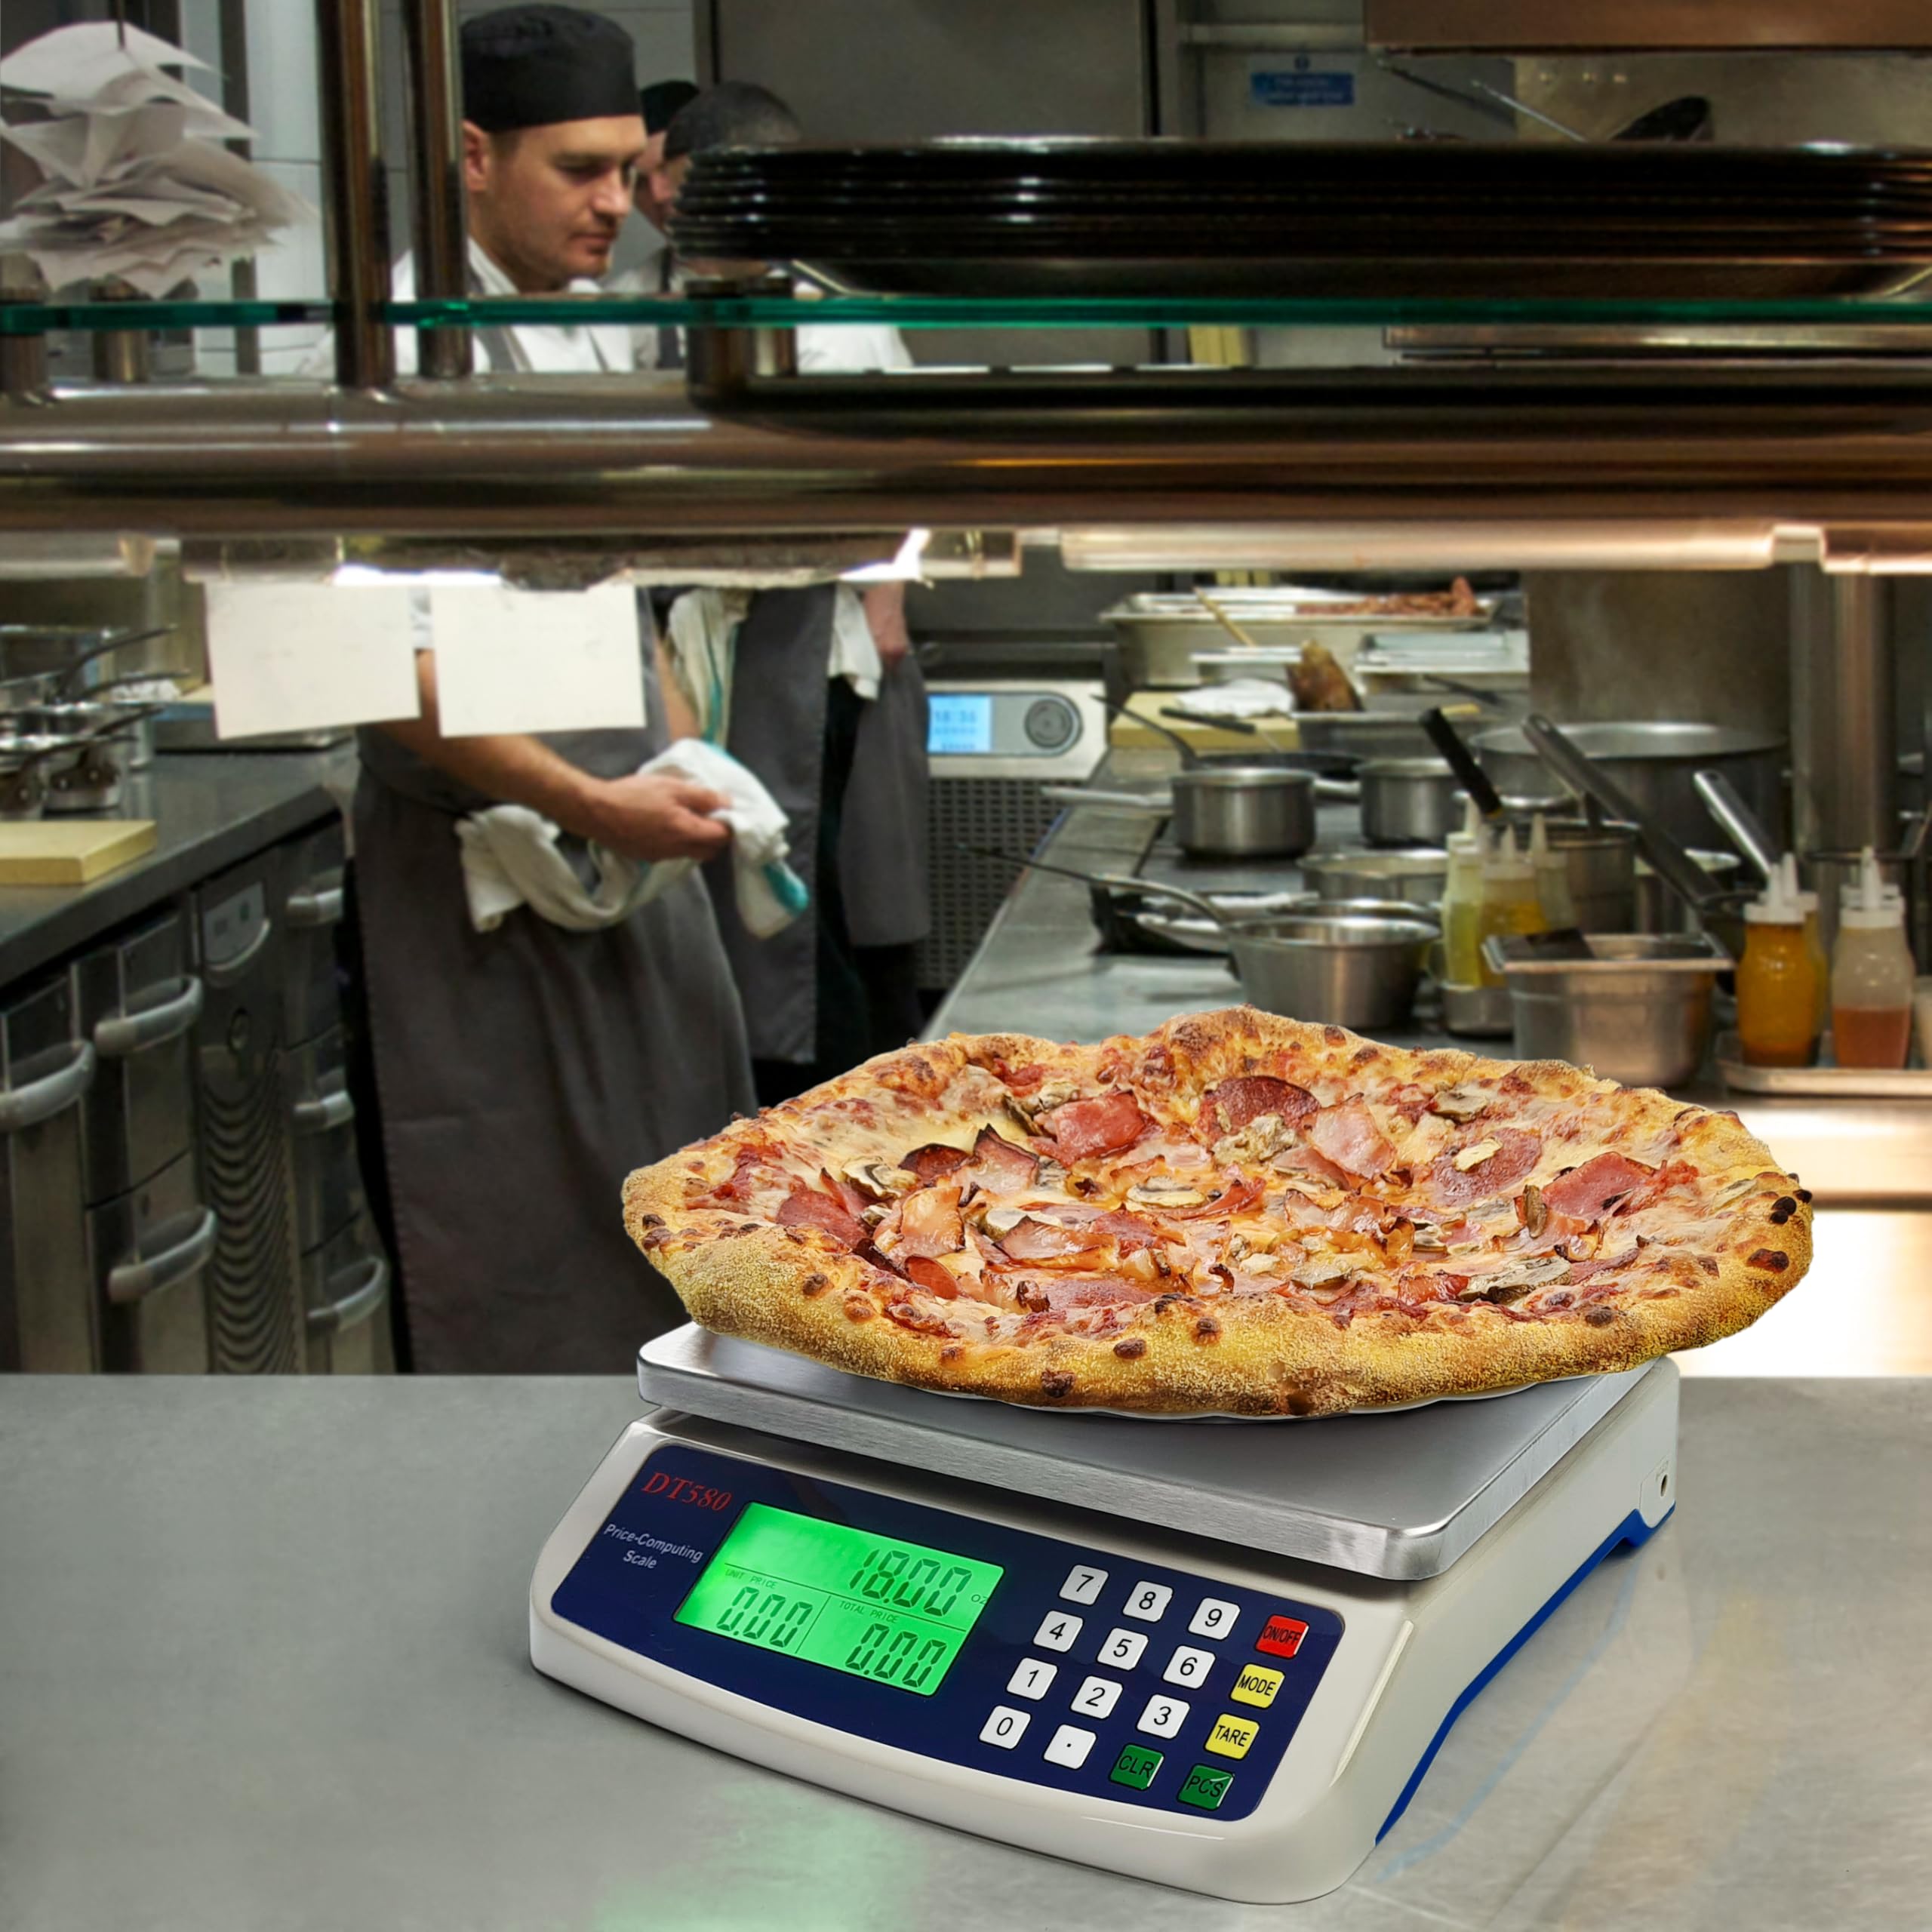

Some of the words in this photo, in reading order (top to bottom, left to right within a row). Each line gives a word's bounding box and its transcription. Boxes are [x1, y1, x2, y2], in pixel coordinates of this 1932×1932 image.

[641, 1472, 733, 1512] DT580
[604, 1523, 703, 1564] Price-Computing
[623, 1549, 657, 1569] Scale
[725, 1569, 745, 1580] UNIT
[750, 1576, 778, 1589] PRICE
[1076, 1574, 1094, 1592] 7
[1138, 1591, 1157, 1611] 8
[839, 1601, 866, 1614] TOTAL
[869, 1610, 900, 1623] PRICE
[1204, 1608, 1223, 1628] 9
[1049, 1622, 1066, 1641] 4
[1263, 1625, 1303, 1644] ON/OFF
[1113, 1638, 1132, 1658] 5
[1180, 1657, 1198, 1676] 6
[1027, 1669, 1040, 1688] 1
[1237, 1674, 1277, 1697] MODE
[1085, 1687, 1106, 1707] 2
[1153, 1706, 1172, 1726] 3
[996, 1717, 1014, 1737] 0
[1214, 1725, 1251, 1747] TARE
[1118, 1755, 1155, 1779] CLR
[1186, 1775, 1224, 1798] PCS
